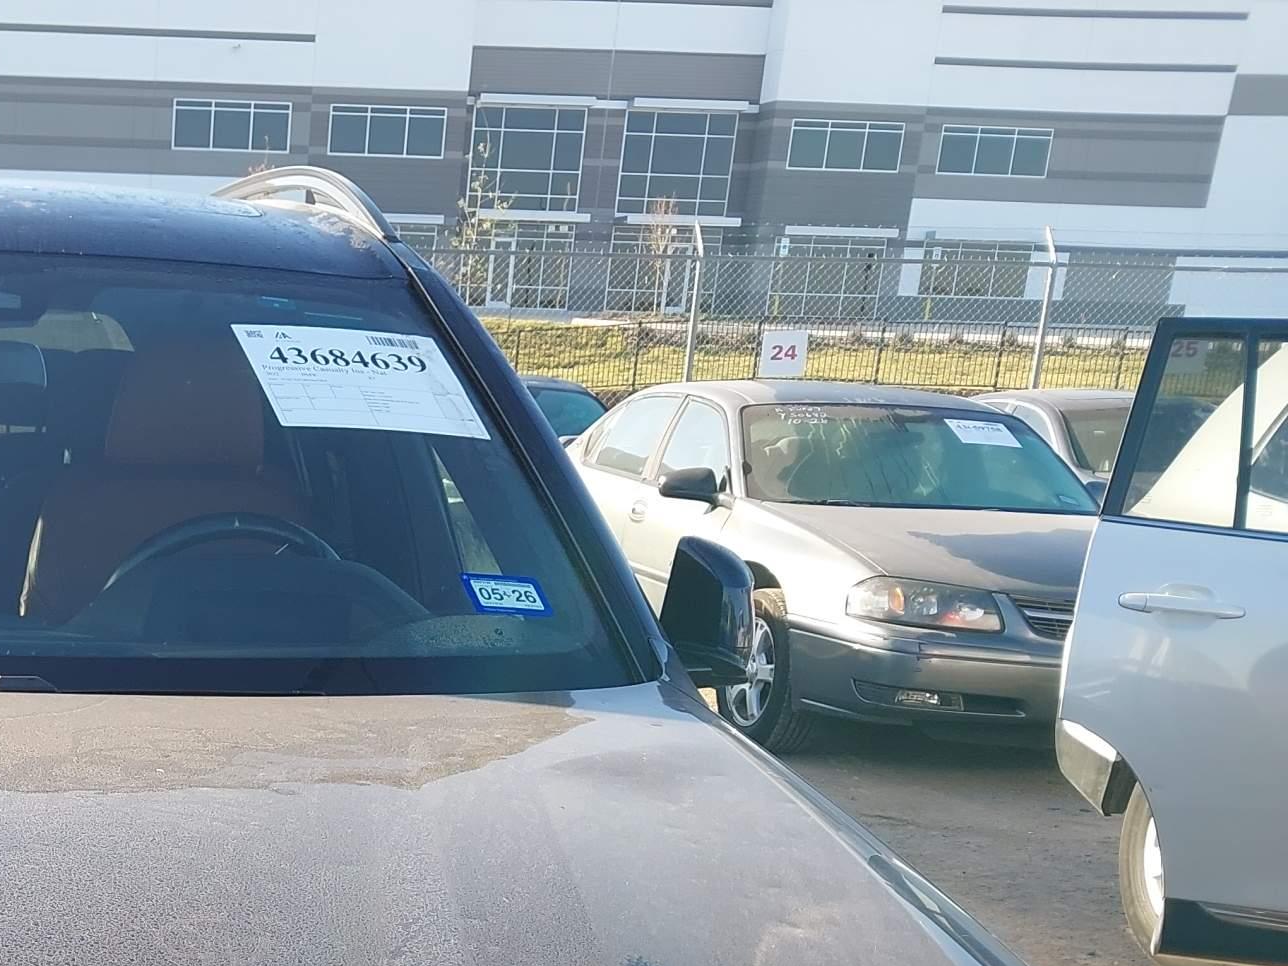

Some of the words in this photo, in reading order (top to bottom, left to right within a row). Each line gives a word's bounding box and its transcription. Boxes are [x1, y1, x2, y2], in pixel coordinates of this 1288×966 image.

[770, 344, 798, 361] 24
[1171, 341, 1200, 358] 25
[269, 346, 427, 373] 43684639
[478, 587, 505, 602] 05
[511, 589, 537, 604] 26
